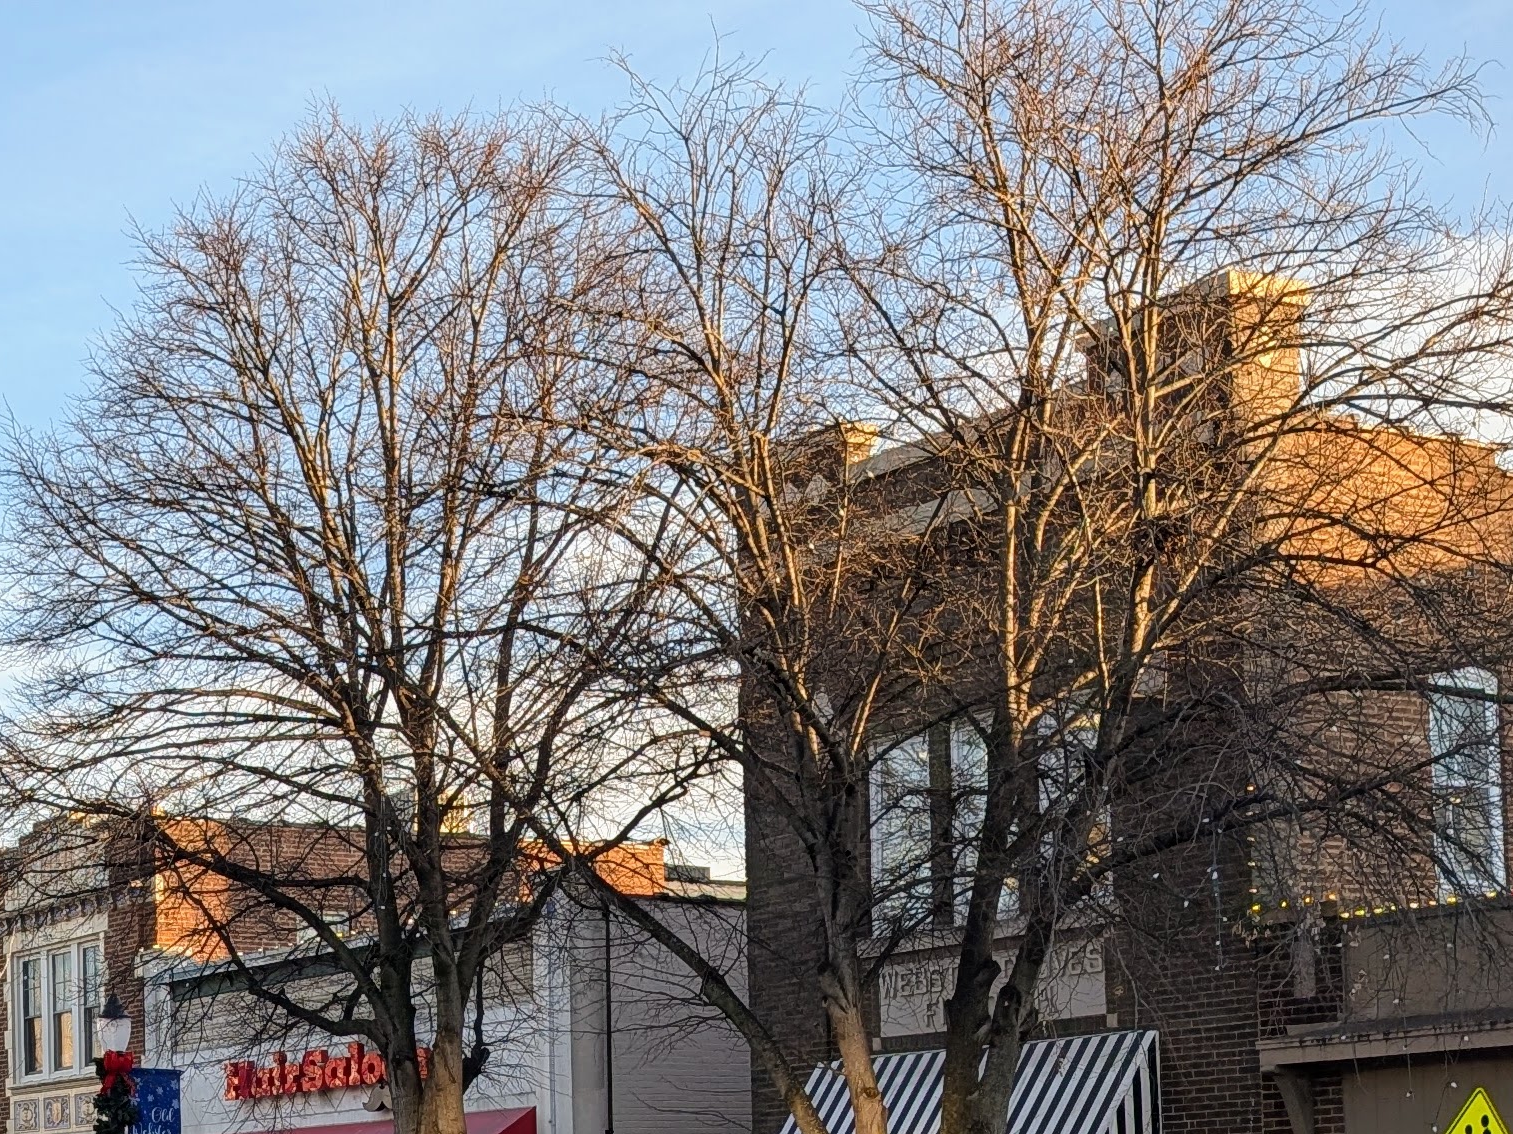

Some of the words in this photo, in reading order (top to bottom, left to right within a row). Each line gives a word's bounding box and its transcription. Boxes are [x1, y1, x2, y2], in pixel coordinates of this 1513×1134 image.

[879, 964, 959, 1000] WEBST
[302, 1042, 432, 1092] Salo
[151, 1106, 176, 1123] Old
